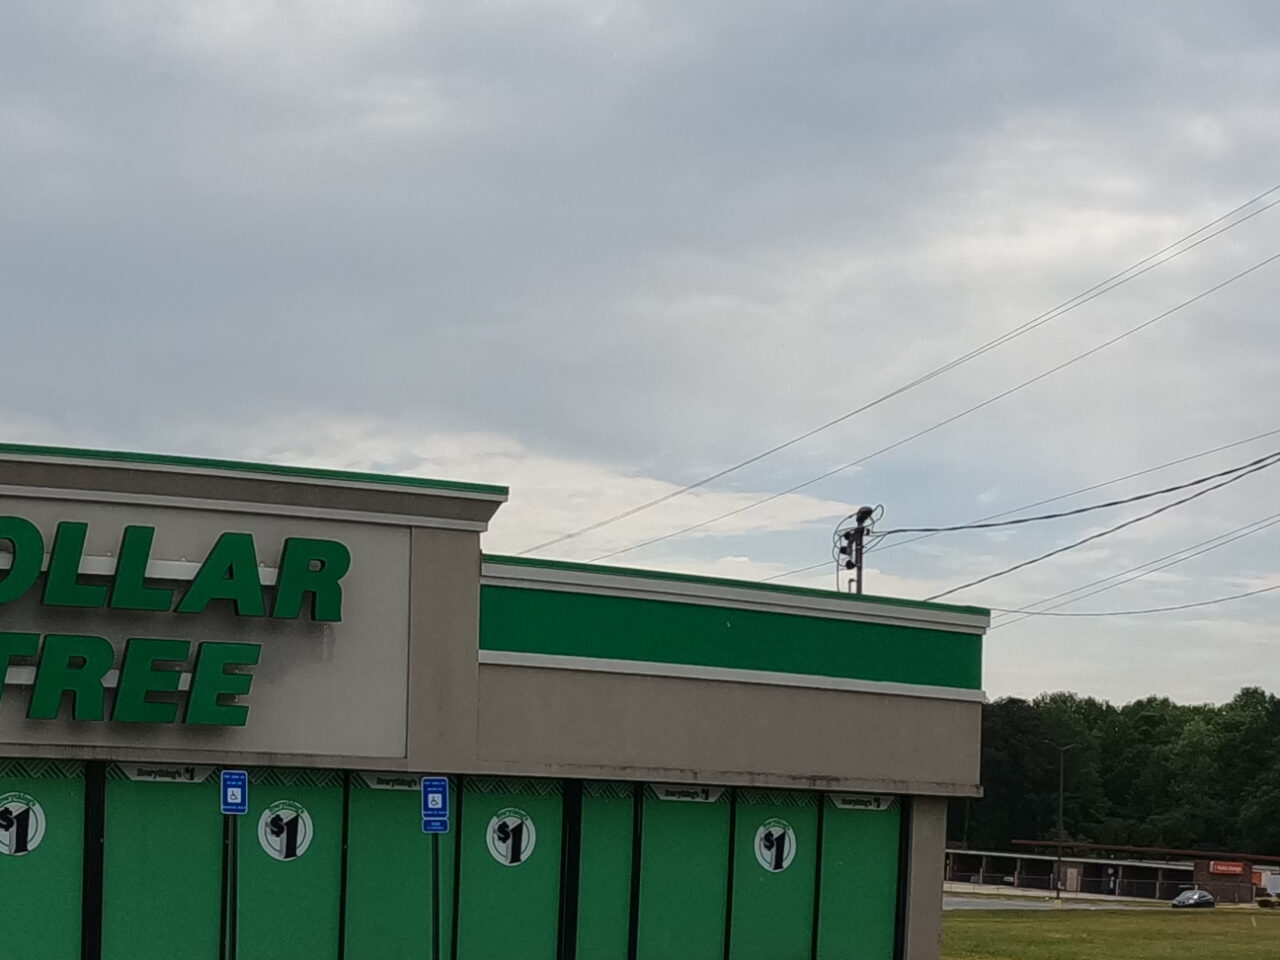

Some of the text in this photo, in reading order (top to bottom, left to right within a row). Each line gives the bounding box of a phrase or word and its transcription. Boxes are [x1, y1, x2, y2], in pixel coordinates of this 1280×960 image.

[270, 813, 300, 859] $1
[497, 821, 524, 864] $1
[763, 830, 787, 870] $1
